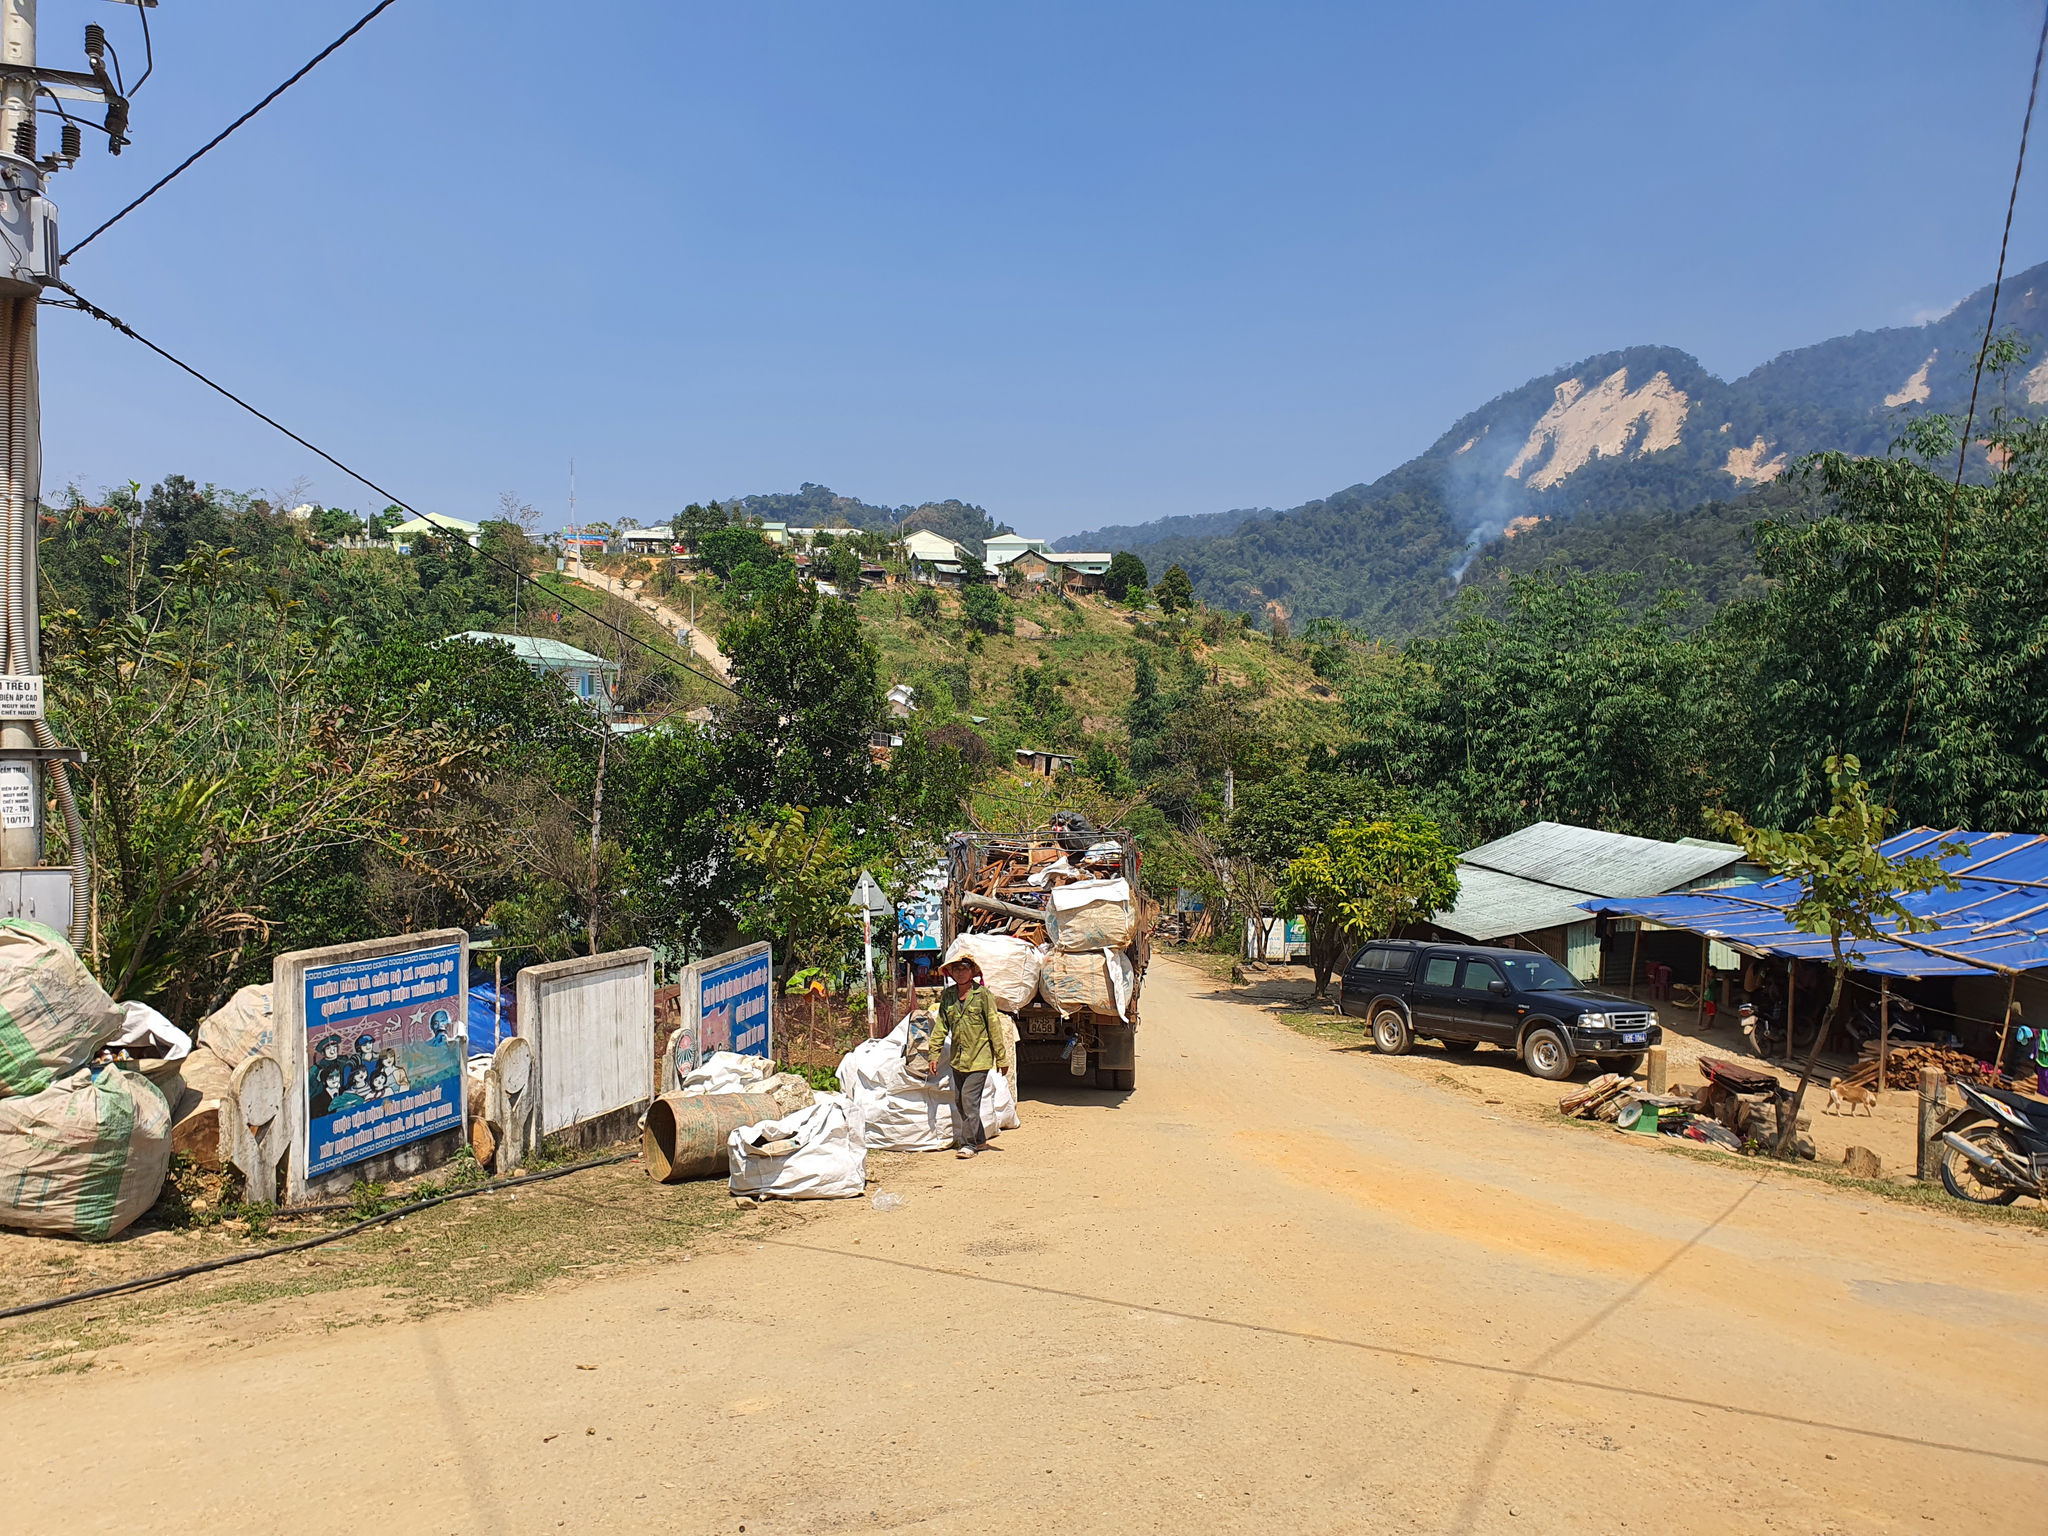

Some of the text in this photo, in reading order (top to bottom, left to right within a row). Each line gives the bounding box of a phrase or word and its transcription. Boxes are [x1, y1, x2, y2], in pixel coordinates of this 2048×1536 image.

[16, 692, 24, 701] ÁP
[25, 694, 38, 702] CAO
[313, 959, 454, 999] NHÂN DÂN VÀ CÁN BỘ XÃ PHƯỚC LỘC
[321, 977, 448, 1018] QUYẾT TÂM THỰC HIỆN THẮNG LỢI
[333, 1115, 351, 1134] CUỘC
[352, 1110, 366, 1128] VẬN
[366, 1105, 384, 1124] ĐỘNG
[320, 1141, 334, 1159] XÂY
[335, 1136, 353, 1154] DỰNG
[354, 1129, 373, 1147] NÔNG
[374, 1122, 390, 1139] THÔN
